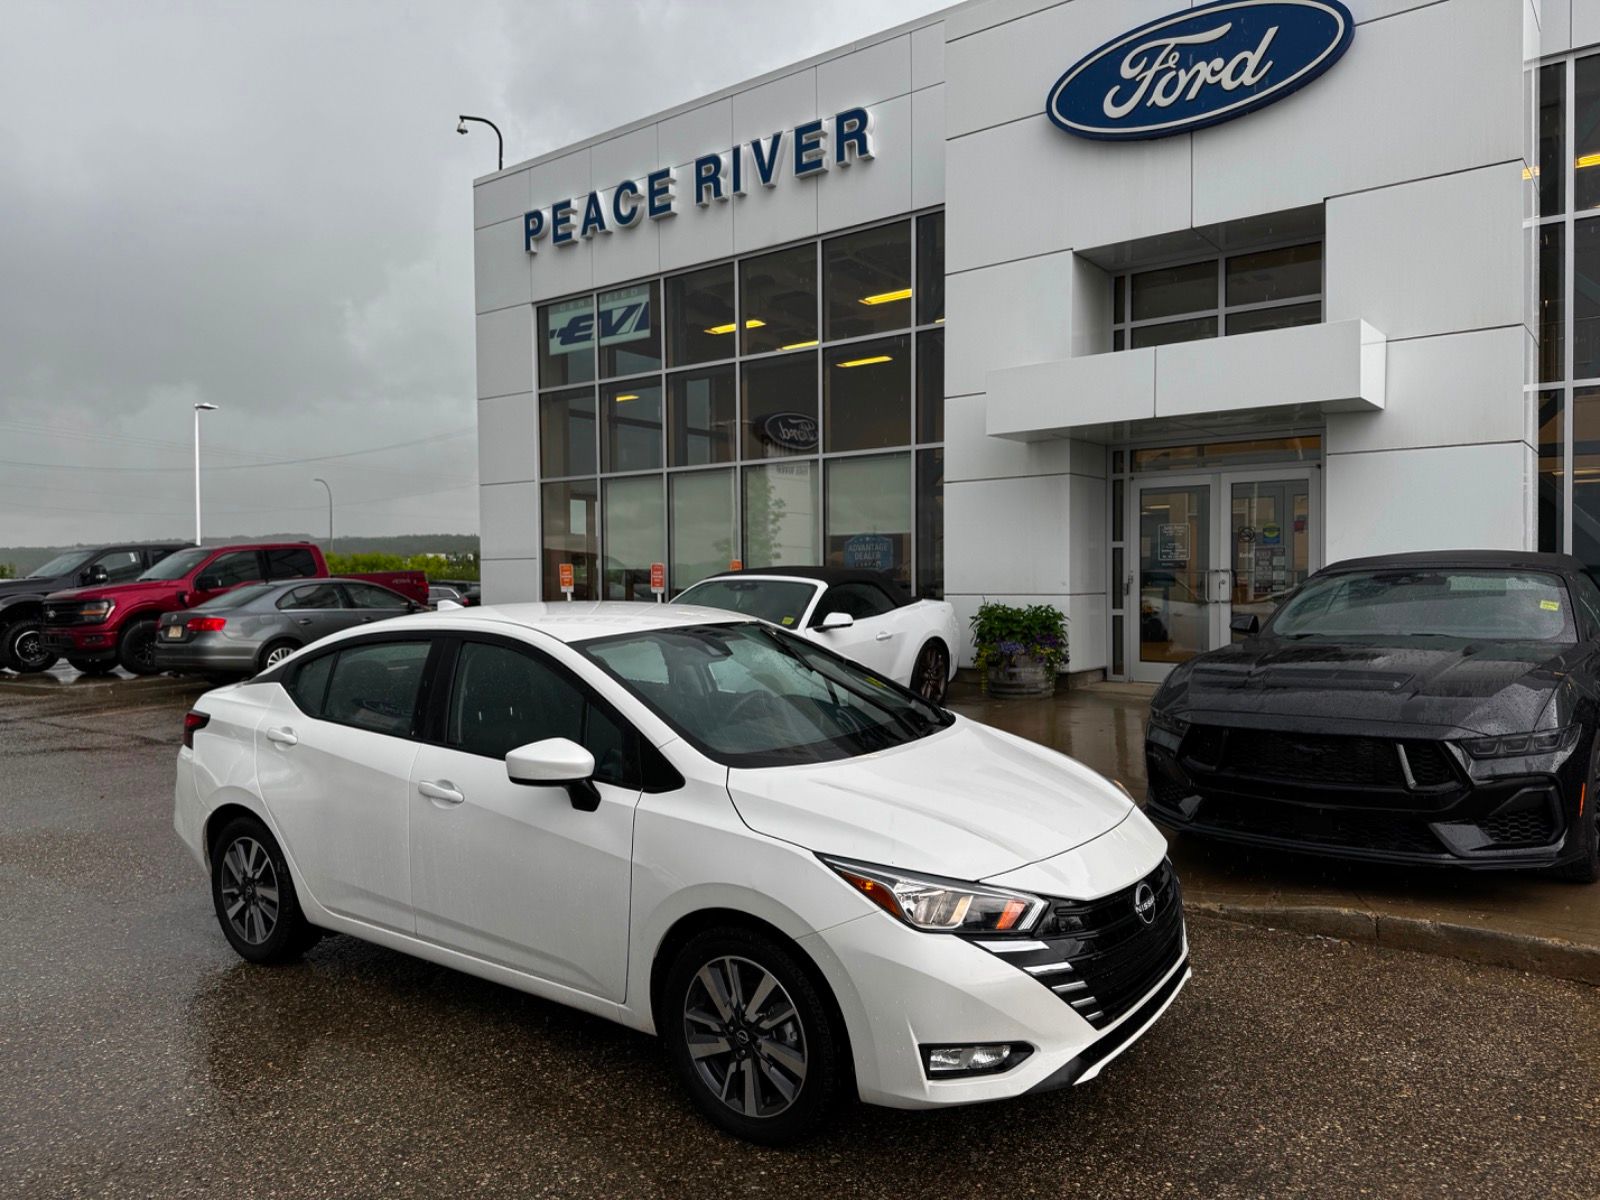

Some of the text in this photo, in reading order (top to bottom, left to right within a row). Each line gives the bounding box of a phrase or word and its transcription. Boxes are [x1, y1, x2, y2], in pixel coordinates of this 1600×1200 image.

[1103, 22, 1279, 119] Ford
[524, 107, 875, 254] PEACE RIVER
[848, 543, 889, 552] ADVANTAGE
